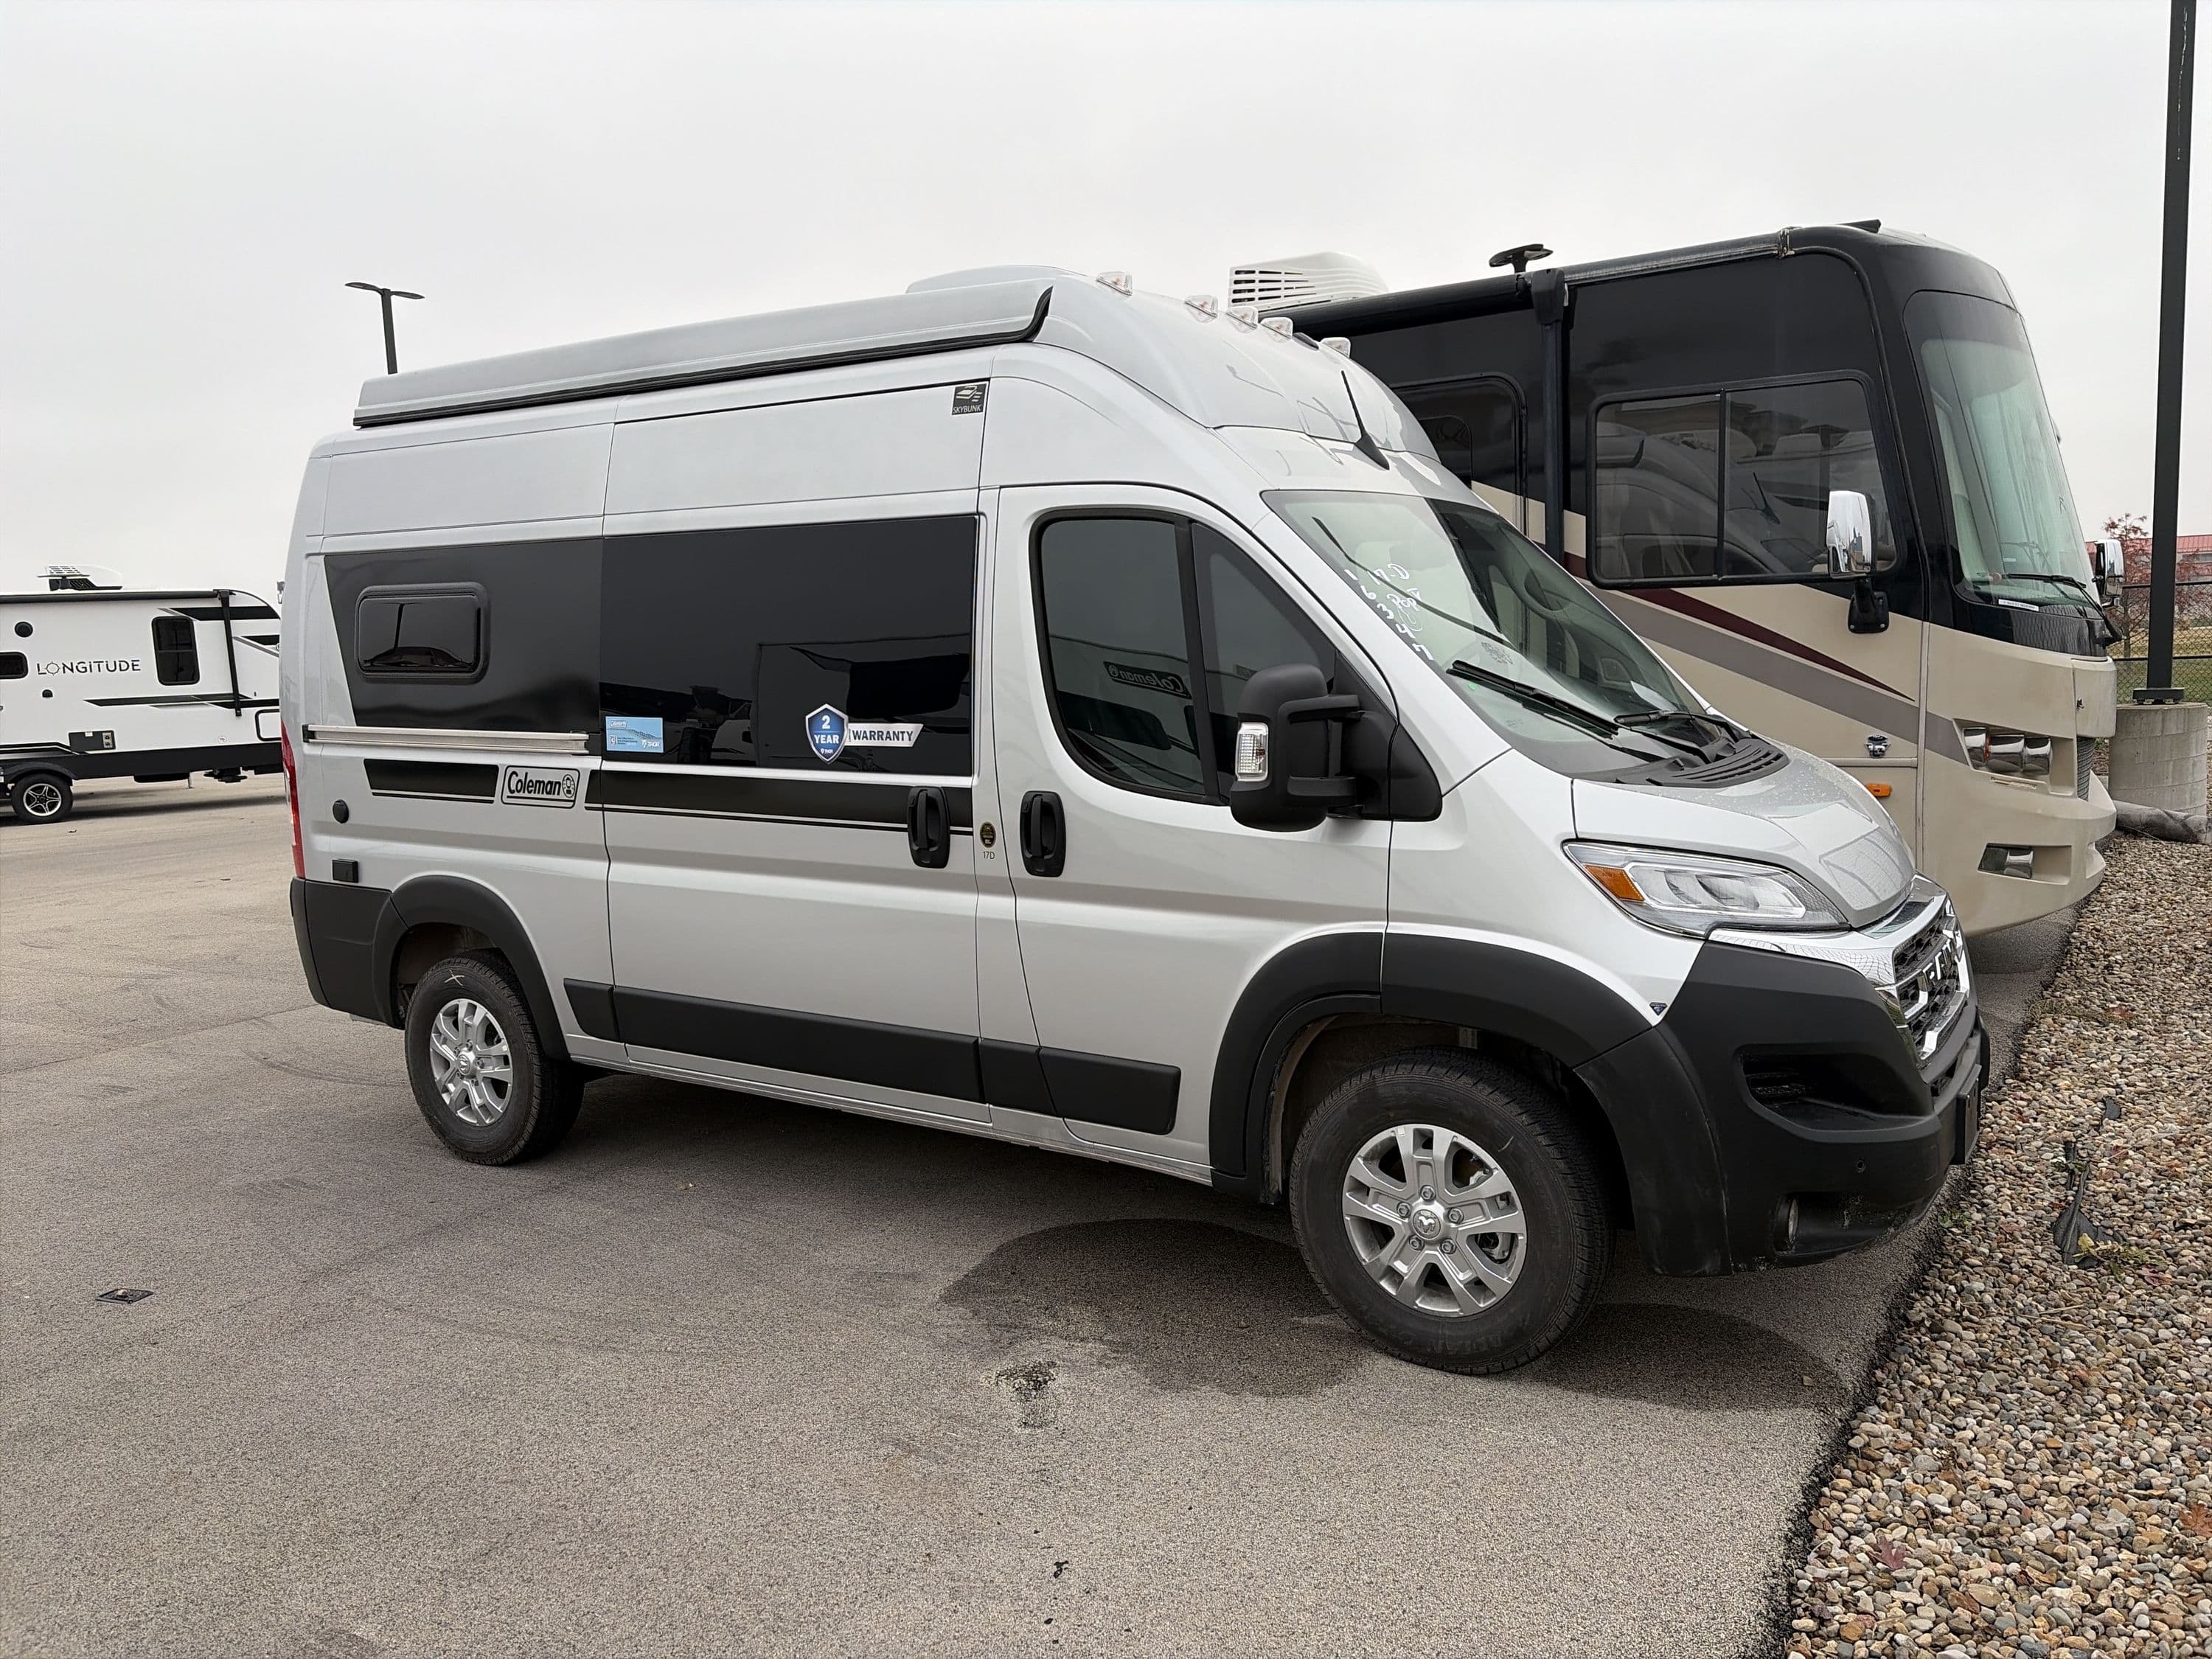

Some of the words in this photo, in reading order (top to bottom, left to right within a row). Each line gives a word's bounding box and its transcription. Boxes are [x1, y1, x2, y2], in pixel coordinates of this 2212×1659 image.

[953, 405, 981, 414] SKYBUNK
[36, 659, 141, 676] LONGITUDE
[821, 715, 831, 729] 2
[814, 734, 840, 744] YEAR
[852, 730, 914, 742] WARRANTY
[507, 771, 562, 796] Coleman
[983, 851, 995, 860] 17D
